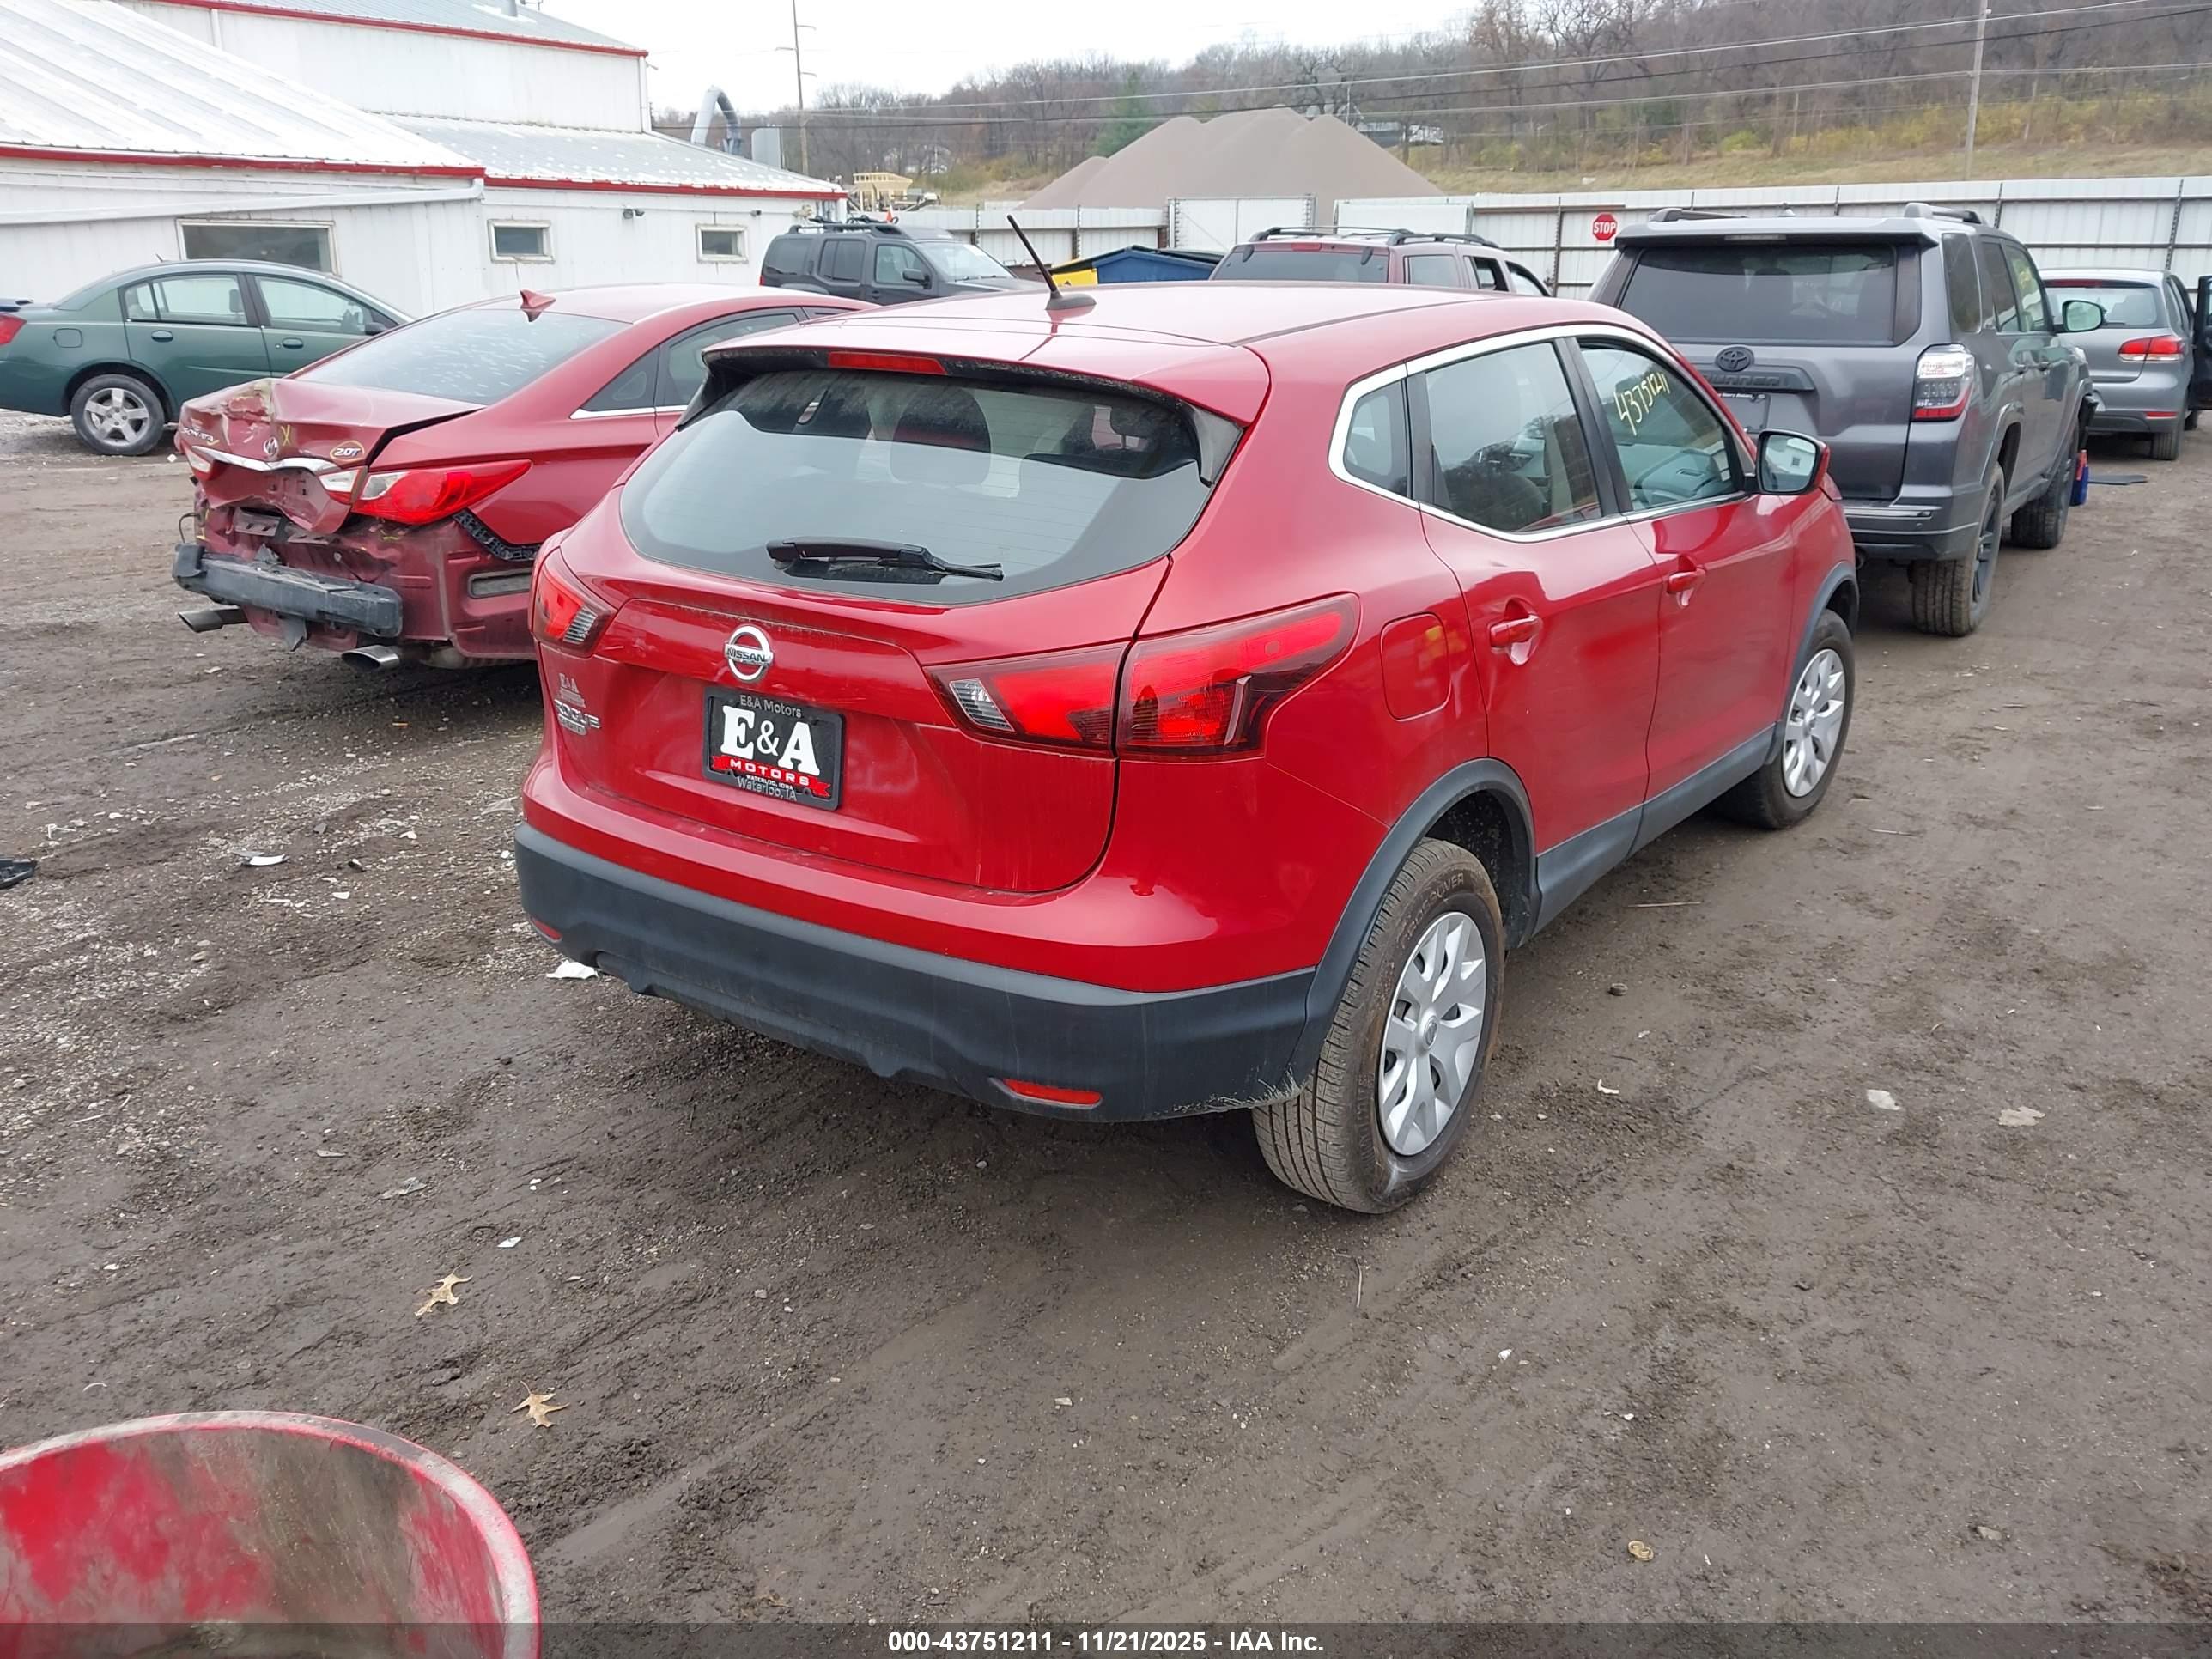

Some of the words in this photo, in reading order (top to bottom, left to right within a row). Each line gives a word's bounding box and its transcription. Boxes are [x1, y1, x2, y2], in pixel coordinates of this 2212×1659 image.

[1594, 222, 1616, 234] STOP
[1613, 371, 1670, 436] 43751211
[726, 647, 766, 663] NISSAN
[740, 694, 763, 710] E&A
[763, 700, 802, 718] Motors
[720, 706, 820, 776] E&A
[730, 758, 810, 786] MOTORS
[737, 776, 783, 799] Waterloo,
